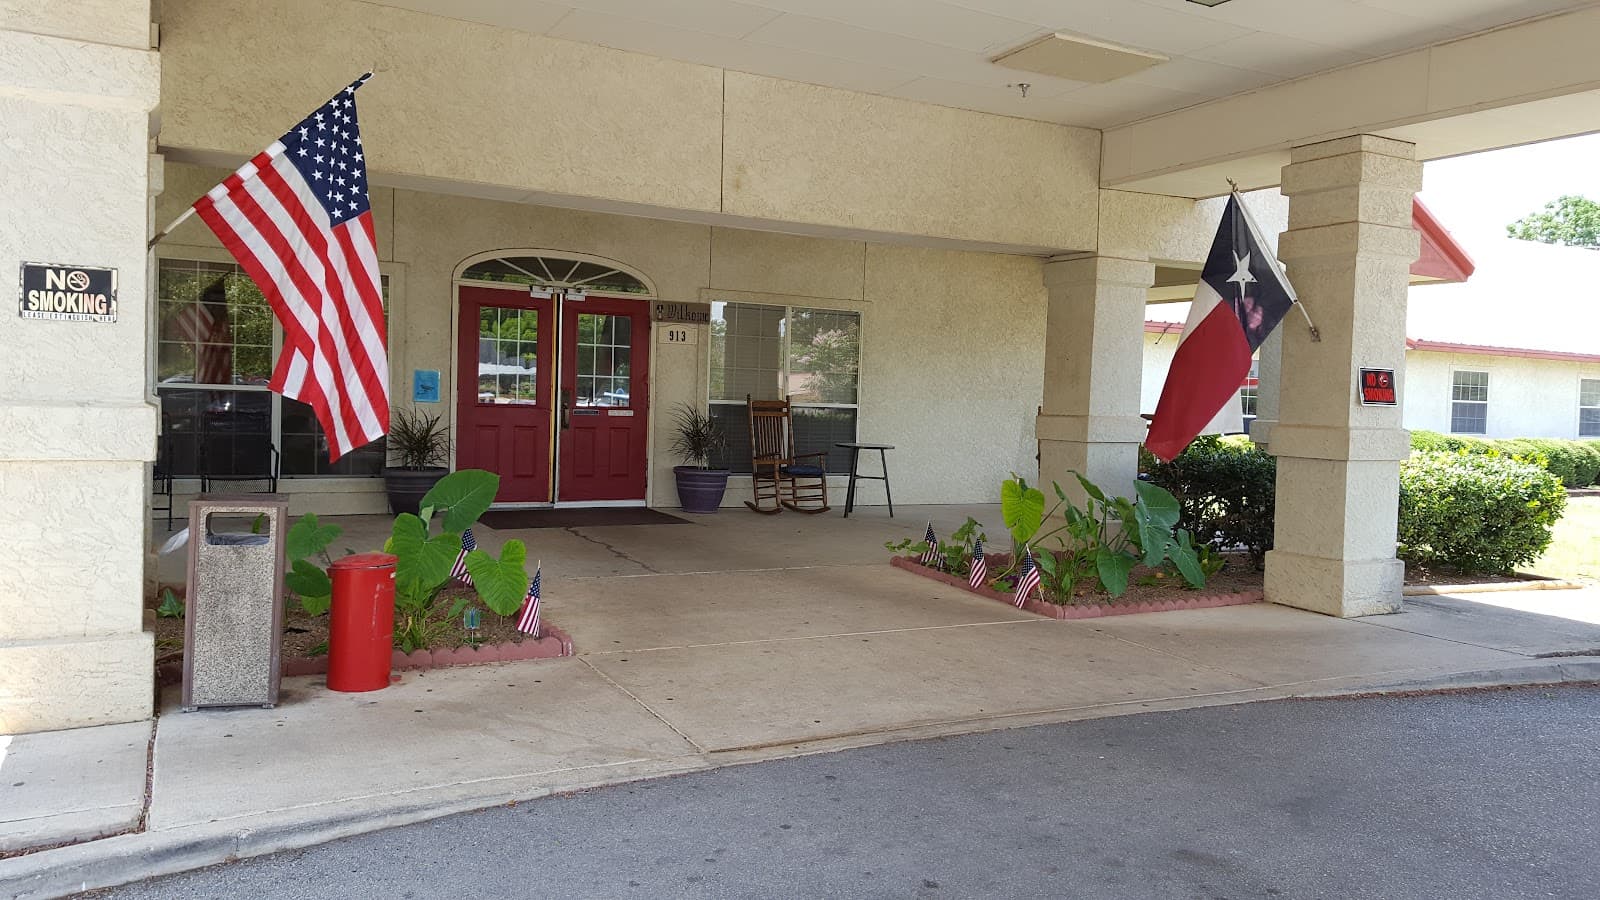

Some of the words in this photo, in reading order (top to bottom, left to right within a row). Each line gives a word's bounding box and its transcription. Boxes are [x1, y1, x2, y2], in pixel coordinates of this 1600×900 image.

[45, 268, 90, 292] NO
[28, 289, 107, 315] SMOKING
[669, 330, 686, 342] 913
[1364, 387, 1394, 402] SMOKING
